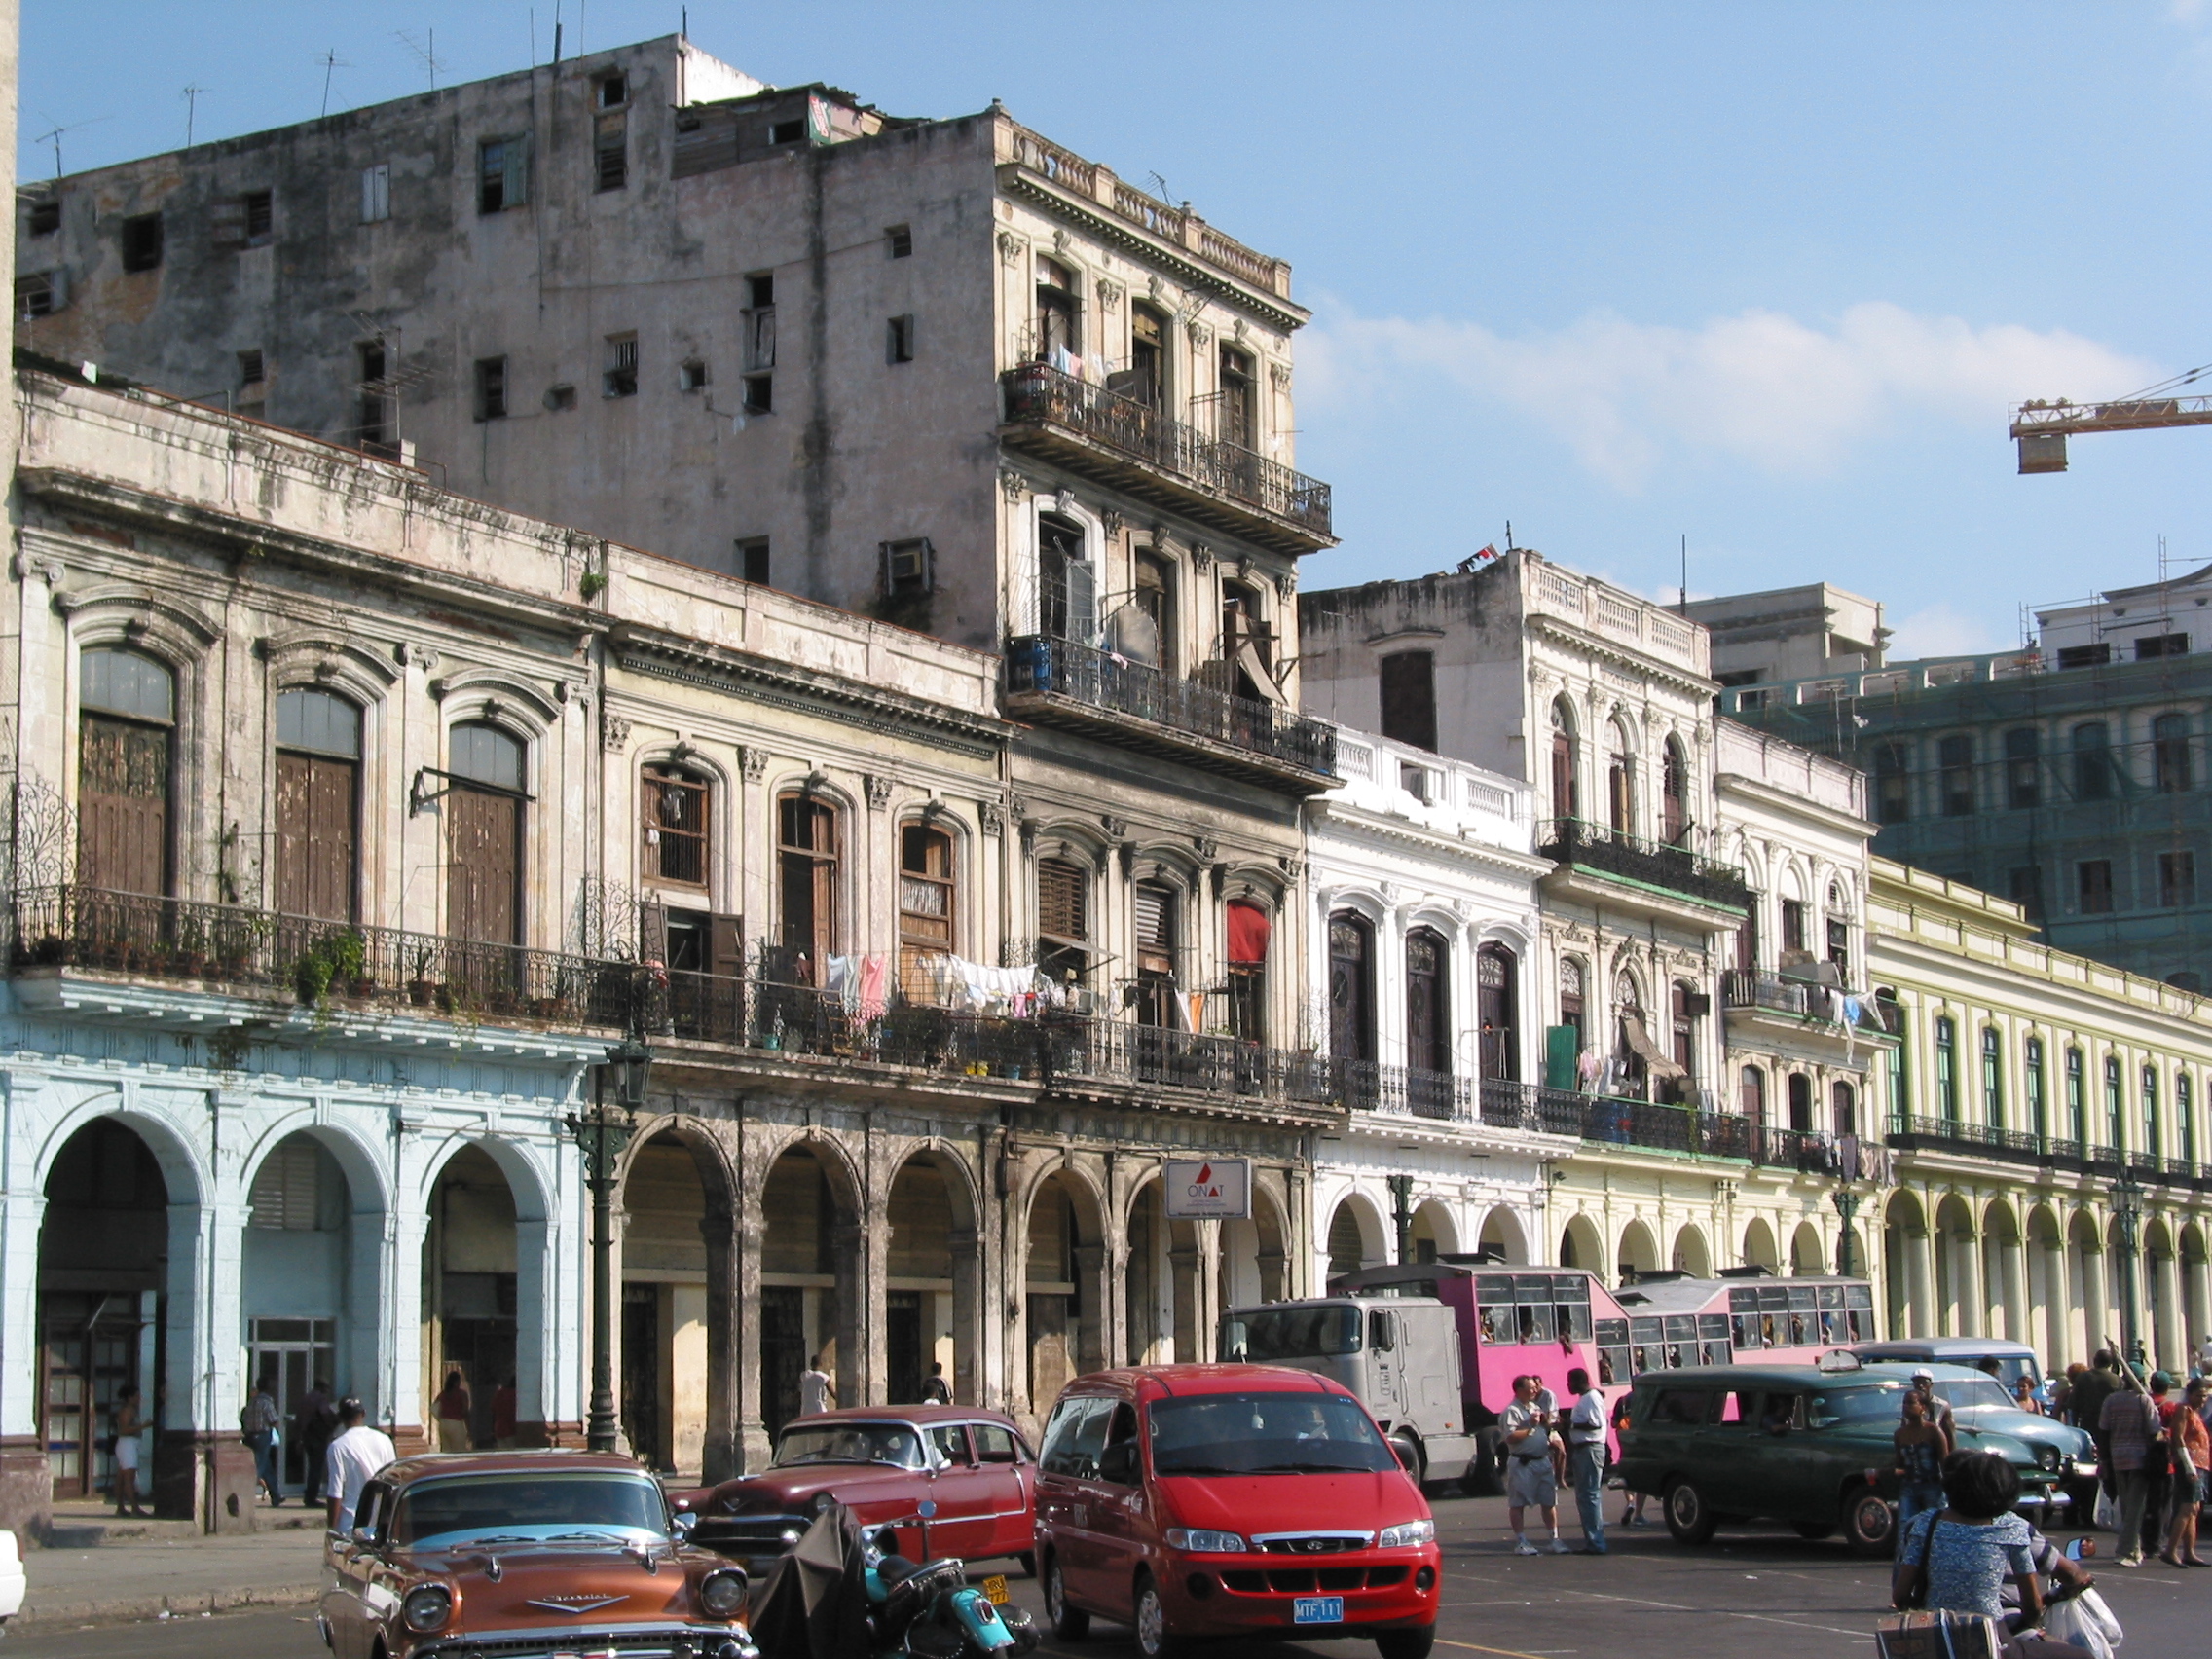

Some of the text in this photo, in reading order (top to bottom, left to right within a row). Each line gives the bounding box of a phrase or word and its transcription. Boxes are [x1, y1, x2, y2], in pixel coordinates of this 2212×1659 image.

[1188, 1185, 1224, 1197] ONAT
[1296, 1602, 1341, 1617] MTF 111
